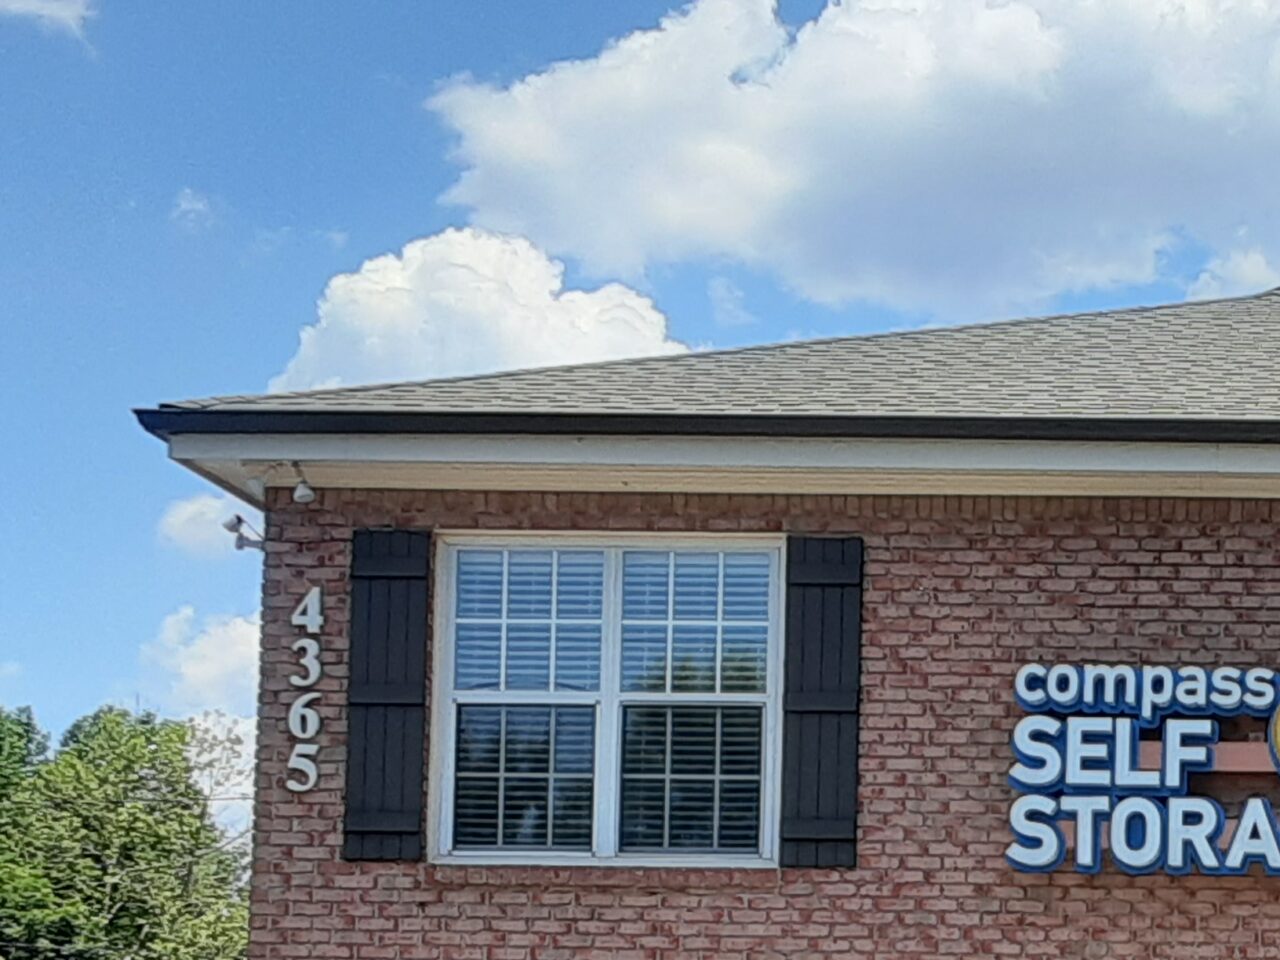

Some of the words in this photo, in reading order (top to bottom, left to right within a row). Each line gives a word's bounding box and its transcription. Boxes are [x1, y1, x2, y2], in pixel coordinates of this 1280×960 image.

[285, 585, 325, 793] 4365
[1013, 662, 1279, 722] compass
[1008, 714, 1216, 790] SELF
